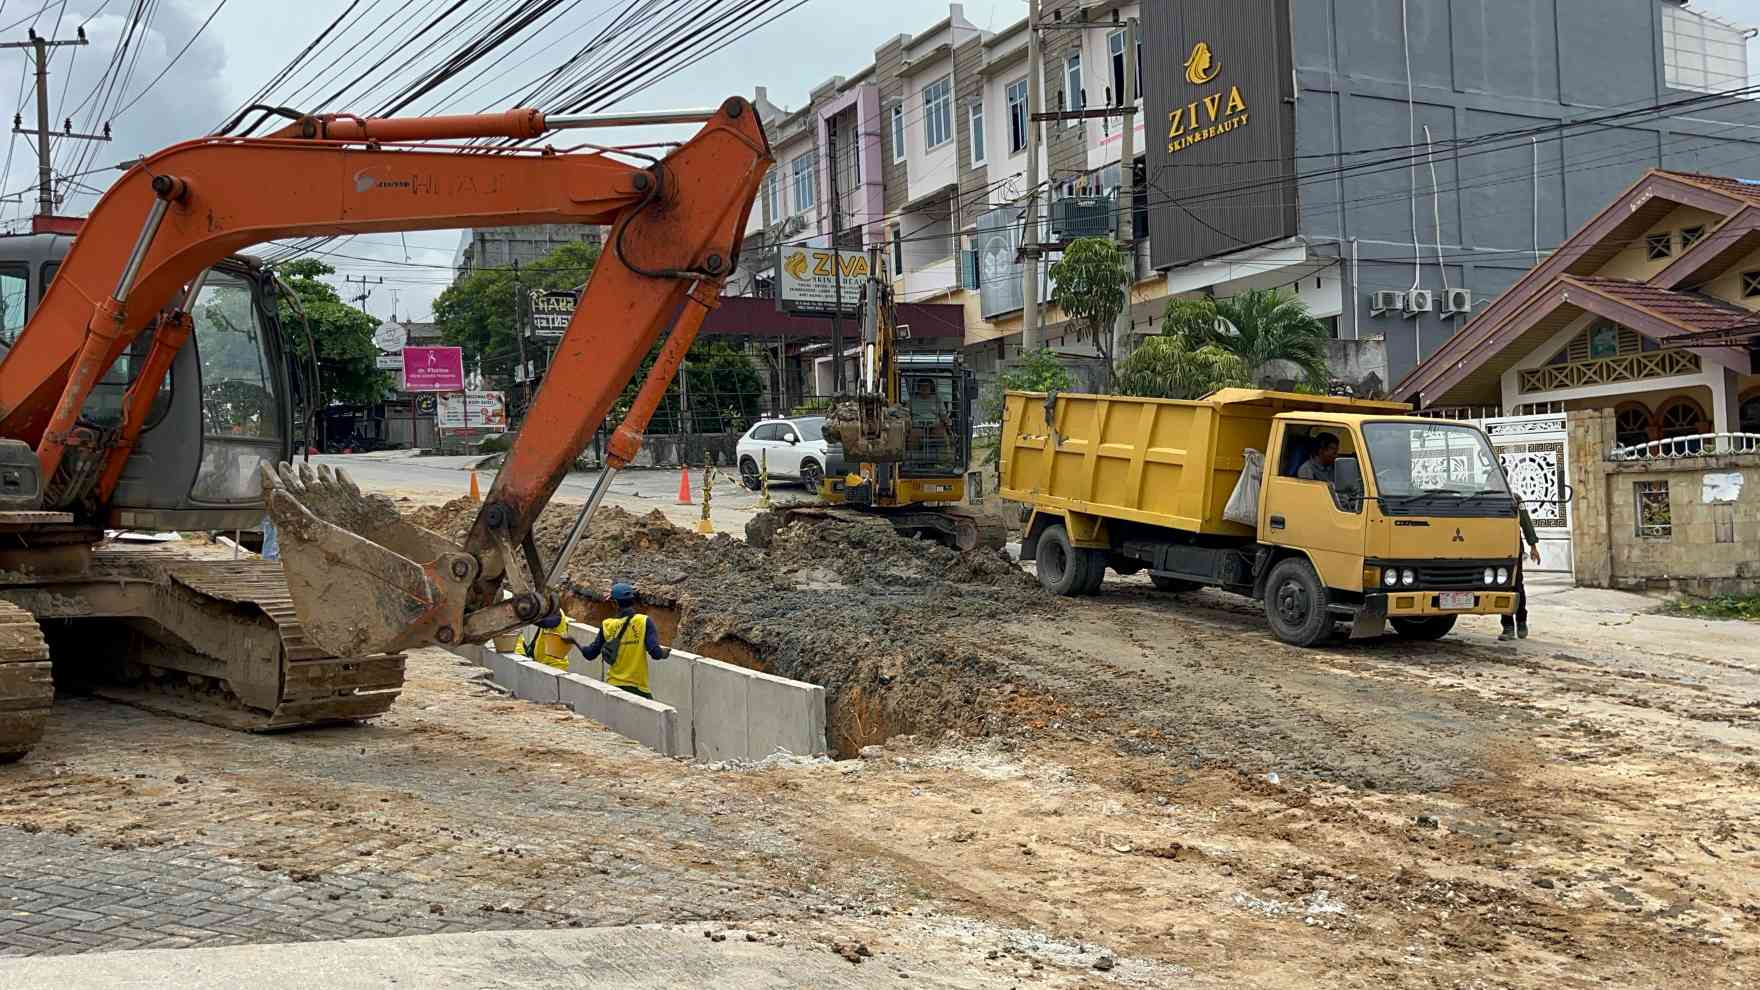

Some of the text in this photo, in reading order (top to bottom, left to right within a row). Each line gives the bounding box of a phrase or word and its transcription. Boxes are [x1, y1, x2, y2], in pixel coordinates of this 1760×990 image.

[1168, 85, 1247, 138] ZIVA
[1168, 113, 1249, 153] SKIN&BEAUTY
[812, 252, 868, 277] ZIVA
